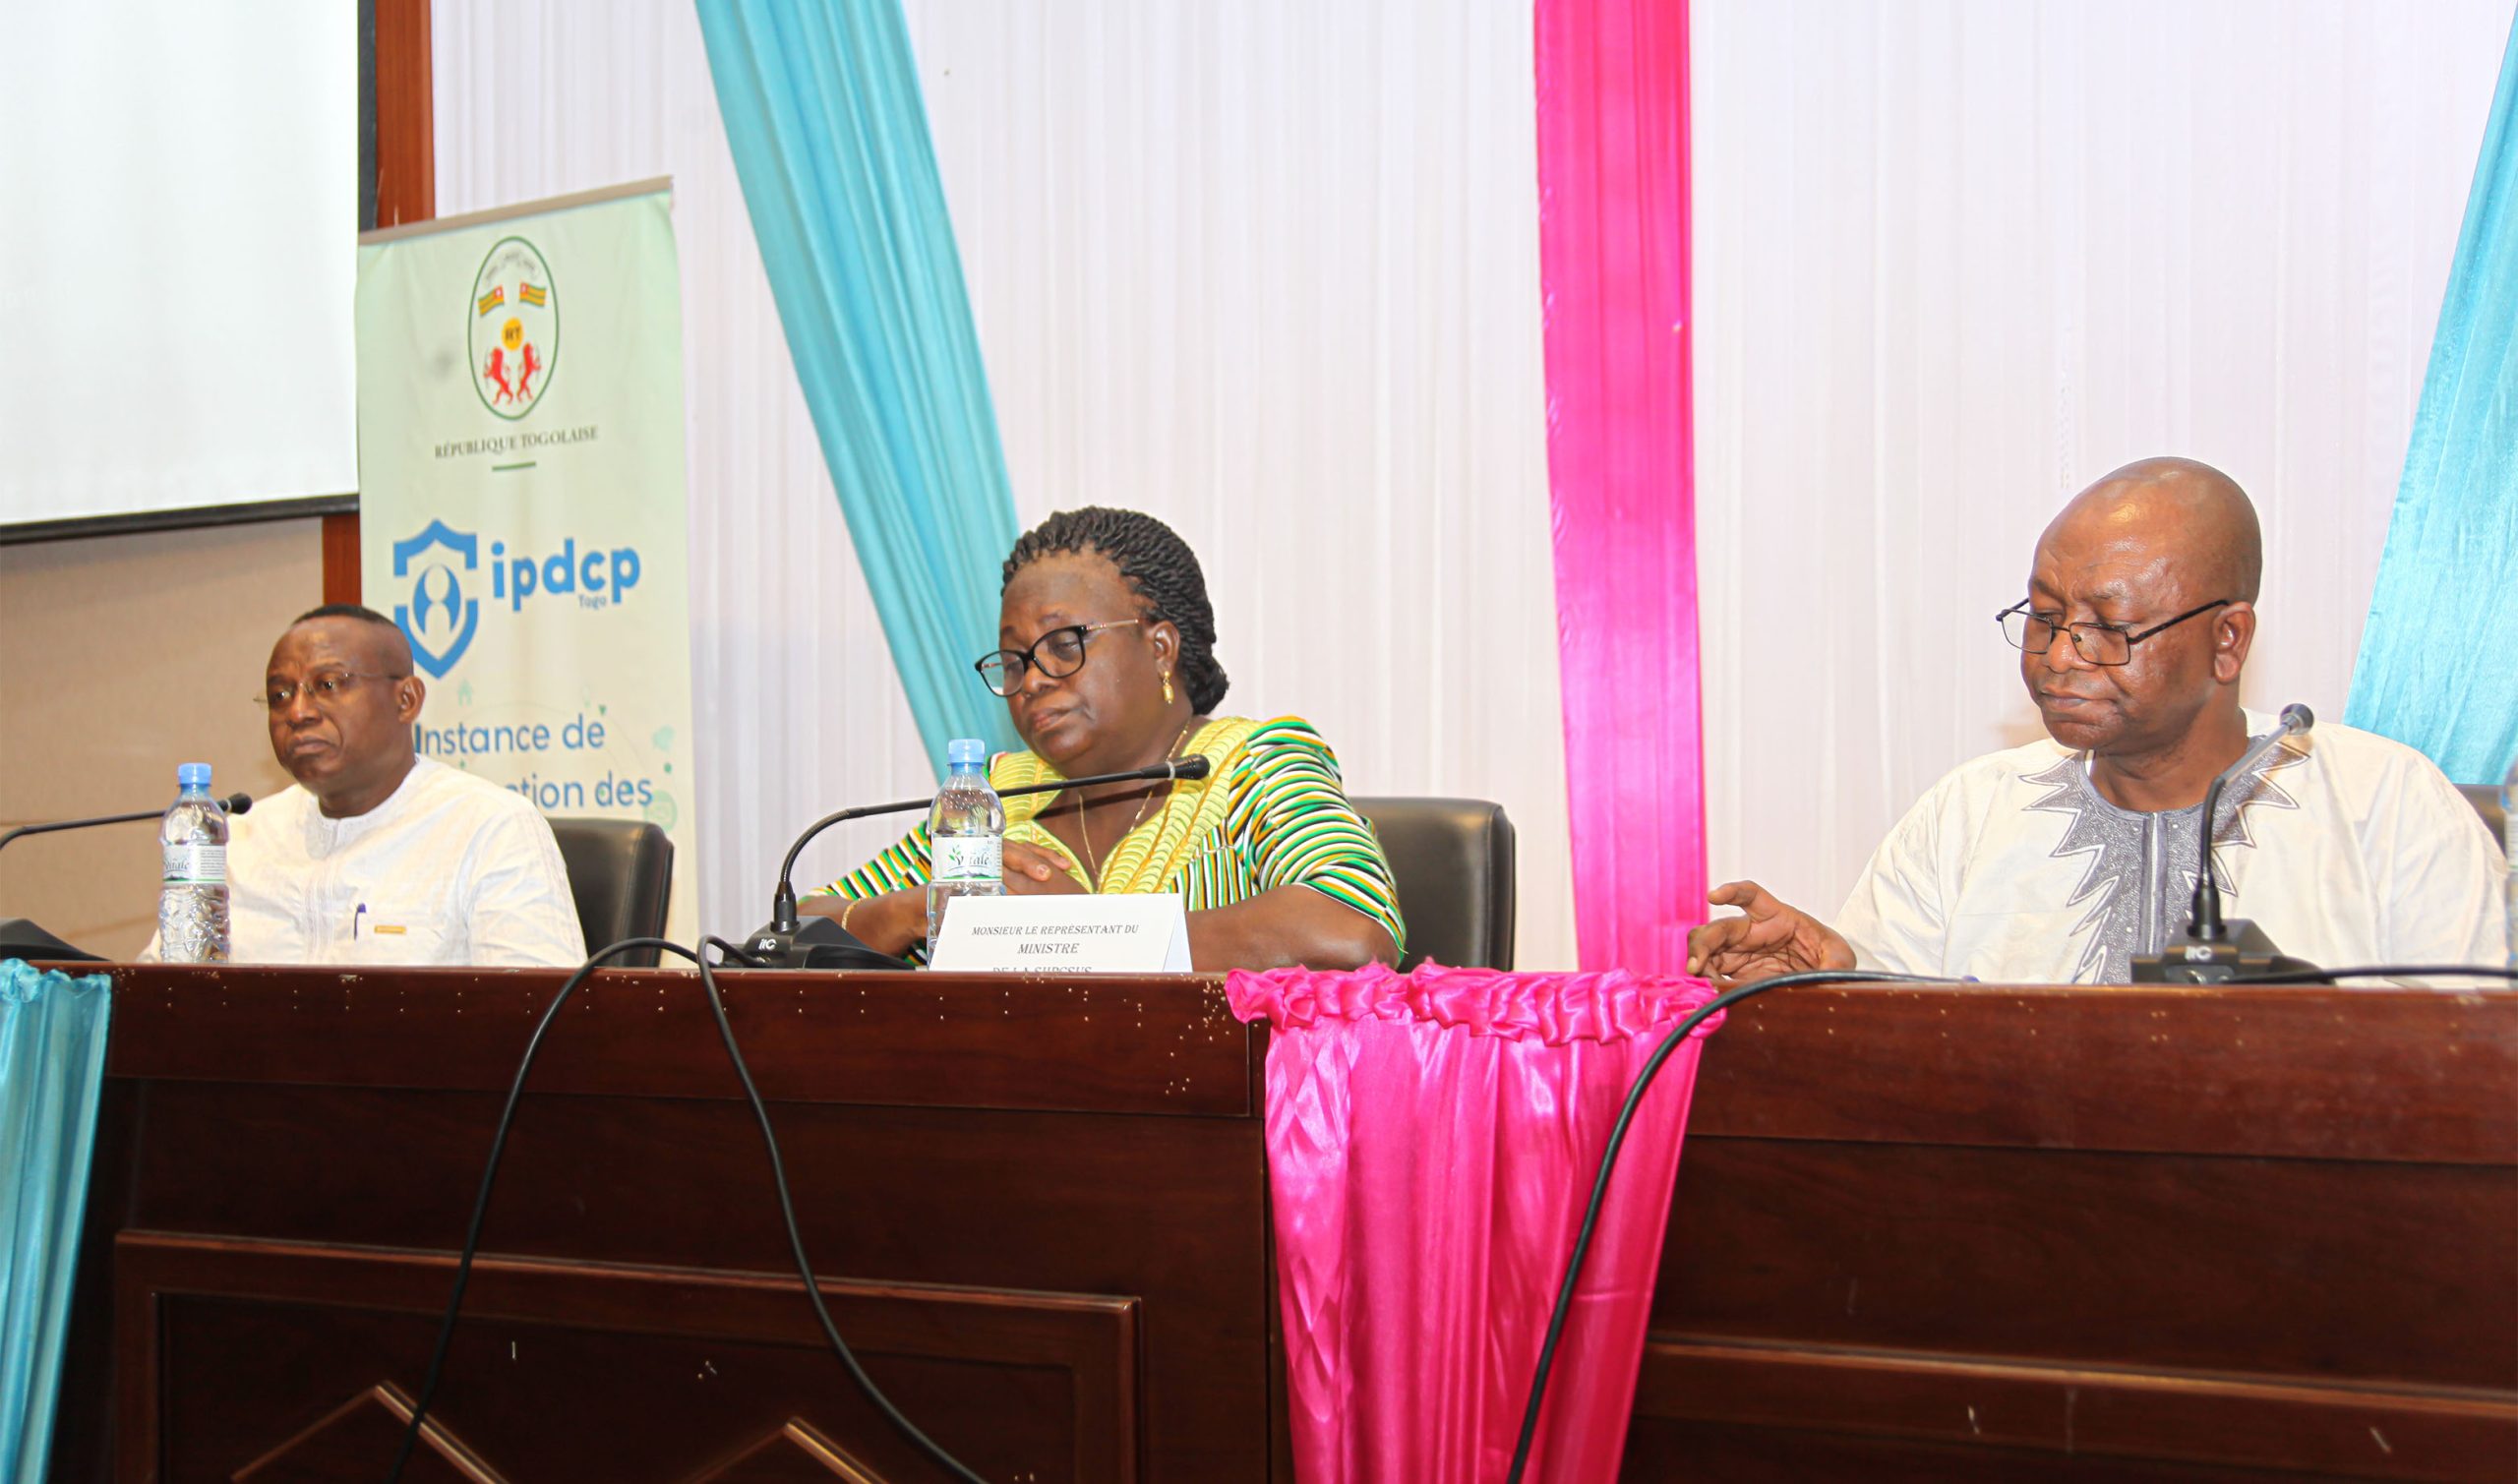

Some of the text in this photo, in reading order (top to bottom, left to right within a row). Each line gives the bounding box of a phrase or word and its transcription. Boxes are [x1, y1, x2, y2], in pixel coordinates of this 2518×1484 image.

[435, 426, 598, 458] RÉPUBLIQUE TOGOLAISE
[491, 537, 640, 612] ipdcp
[414, 713, 605, 755] Instance de
[594, 770, 654, 807] des
[972, 926, 1023, 935] MONSIEUR
[1041, 924, 1122, 934] REPRÉSENTANT
[1124, 924, 1139, 933] DU
[1017, 943, 1080, 954] MINISTRE
